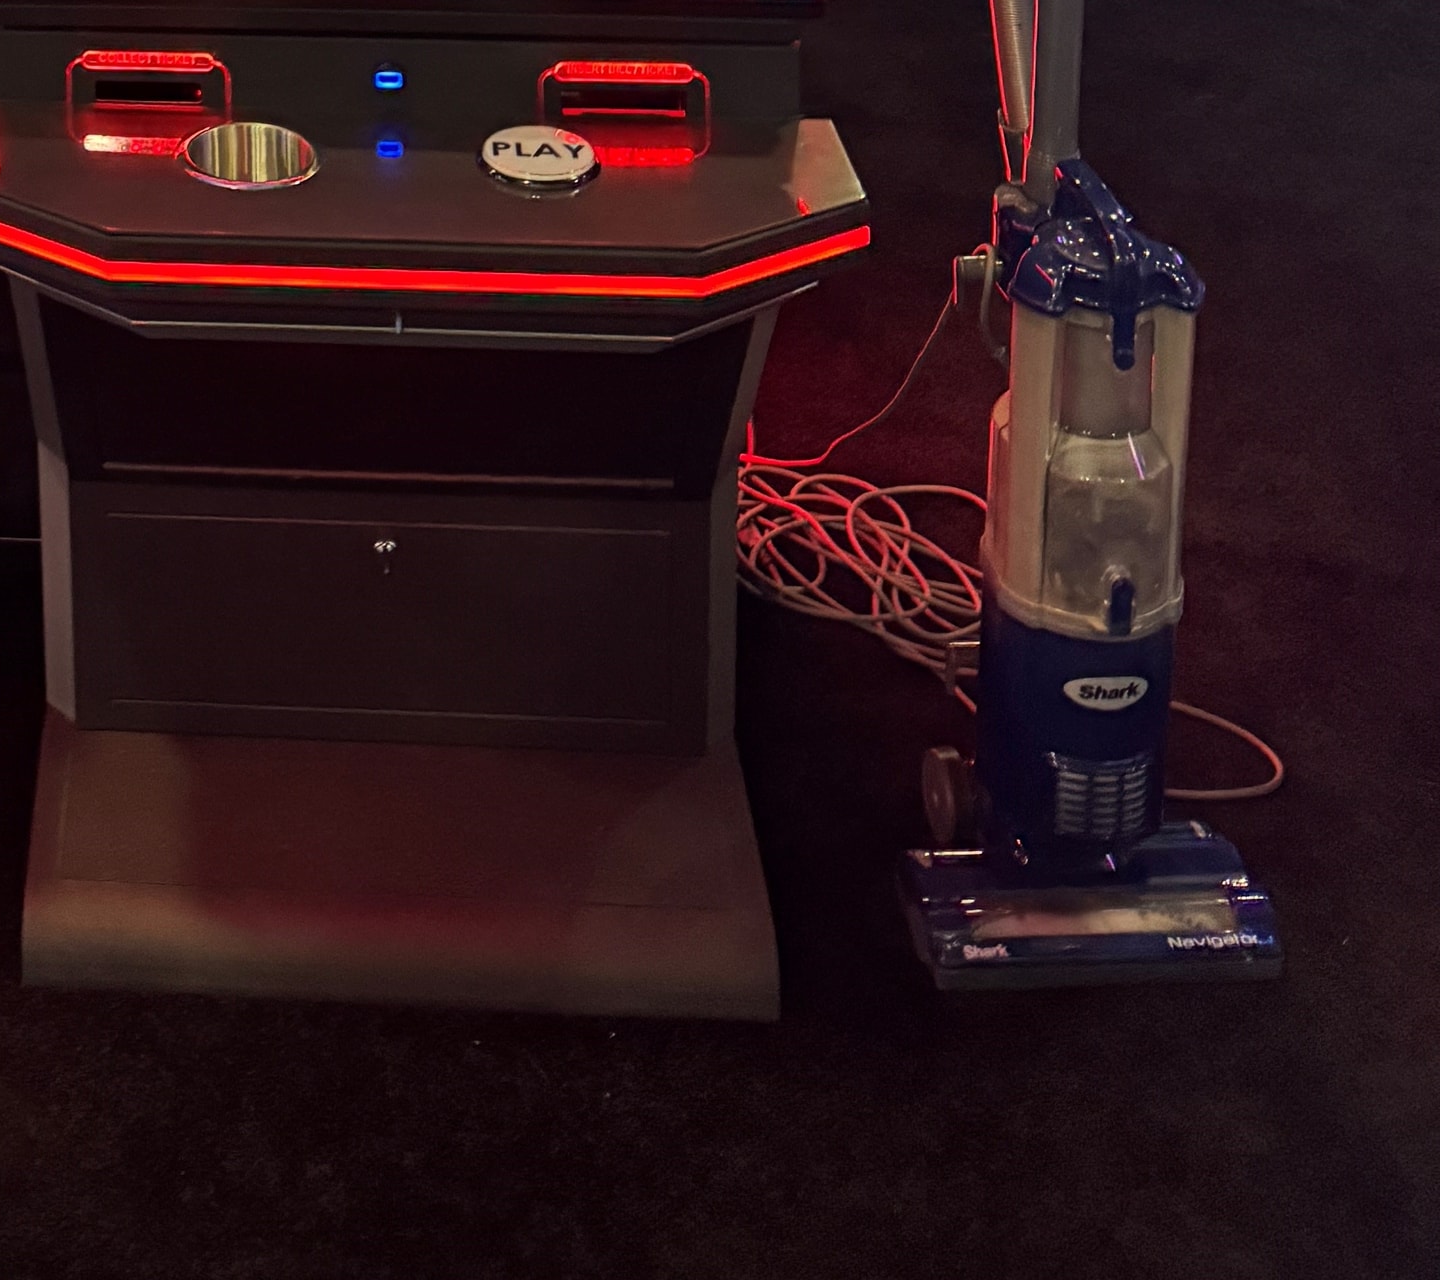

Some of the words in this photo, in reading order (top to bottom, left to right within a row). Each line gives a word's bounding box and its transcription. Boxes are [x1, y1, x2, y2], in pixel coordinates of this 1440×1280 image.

[99, 53, 152, 64] COLLECT
[153, 54, 196, 65] TICKET
[492, 142, 584, 159] PLAY
[1079, 682, 1140, 700] Shark
[1167, 934, 1259, 951] Navigator
[963, 944, 1009, 960] Shark
